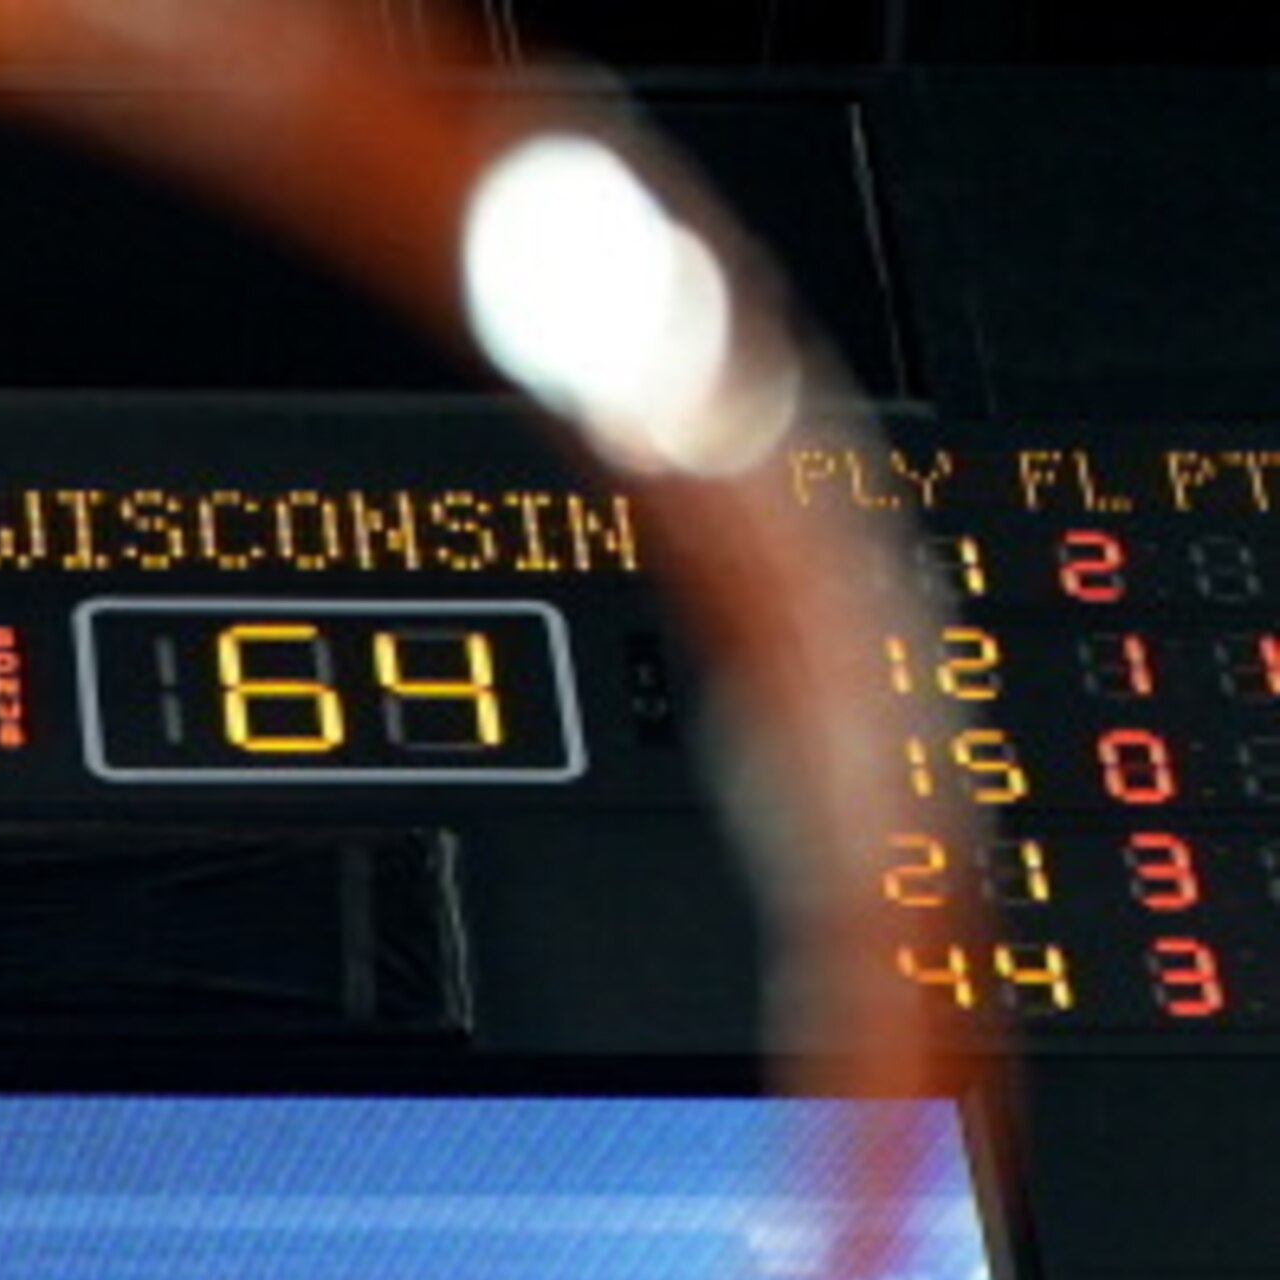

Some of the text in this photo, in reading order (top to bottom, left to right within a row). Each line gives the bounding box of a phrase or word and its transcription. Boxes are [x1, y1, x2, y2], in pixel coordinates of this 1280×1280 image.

[789, 450, 952, 508] PLY
[1019, 450, 1135, 513] FL
[959, 529, 1124, 601] 1 2
[217, 624, 503, 753] 64
[885, 628, 1000, 700] 12
[1124, 634, 1152, 696] 1
[907, 729, 1176, 803] 15 0
[883, 833, 1198, 908] 21 3
[897, 937, 1223, 1016] 44 3
